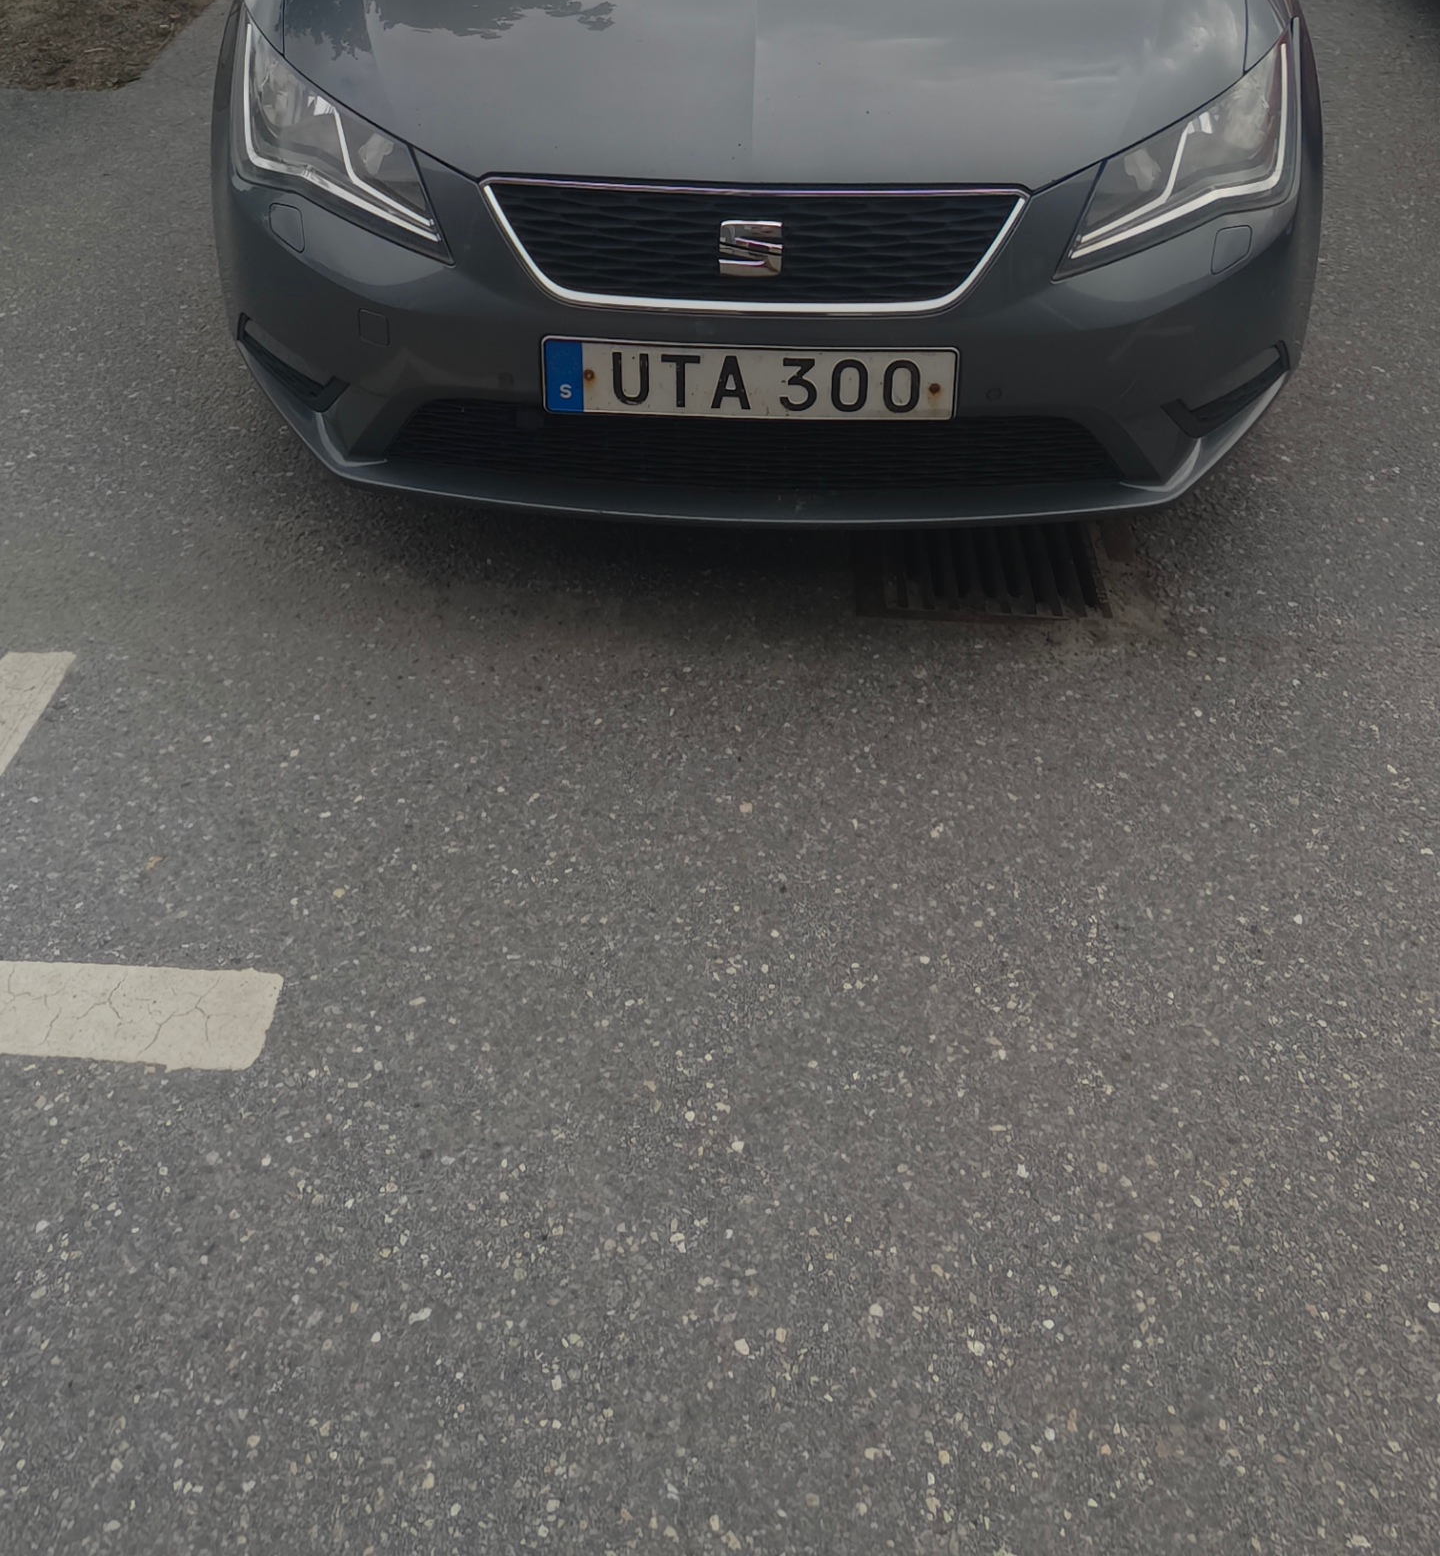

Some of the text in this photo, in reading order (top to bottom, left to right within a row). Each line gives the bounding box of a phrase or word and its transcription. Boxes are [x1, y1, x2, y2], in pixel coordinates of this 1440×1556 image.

[559, 351, 922, 413] S UTA 300
